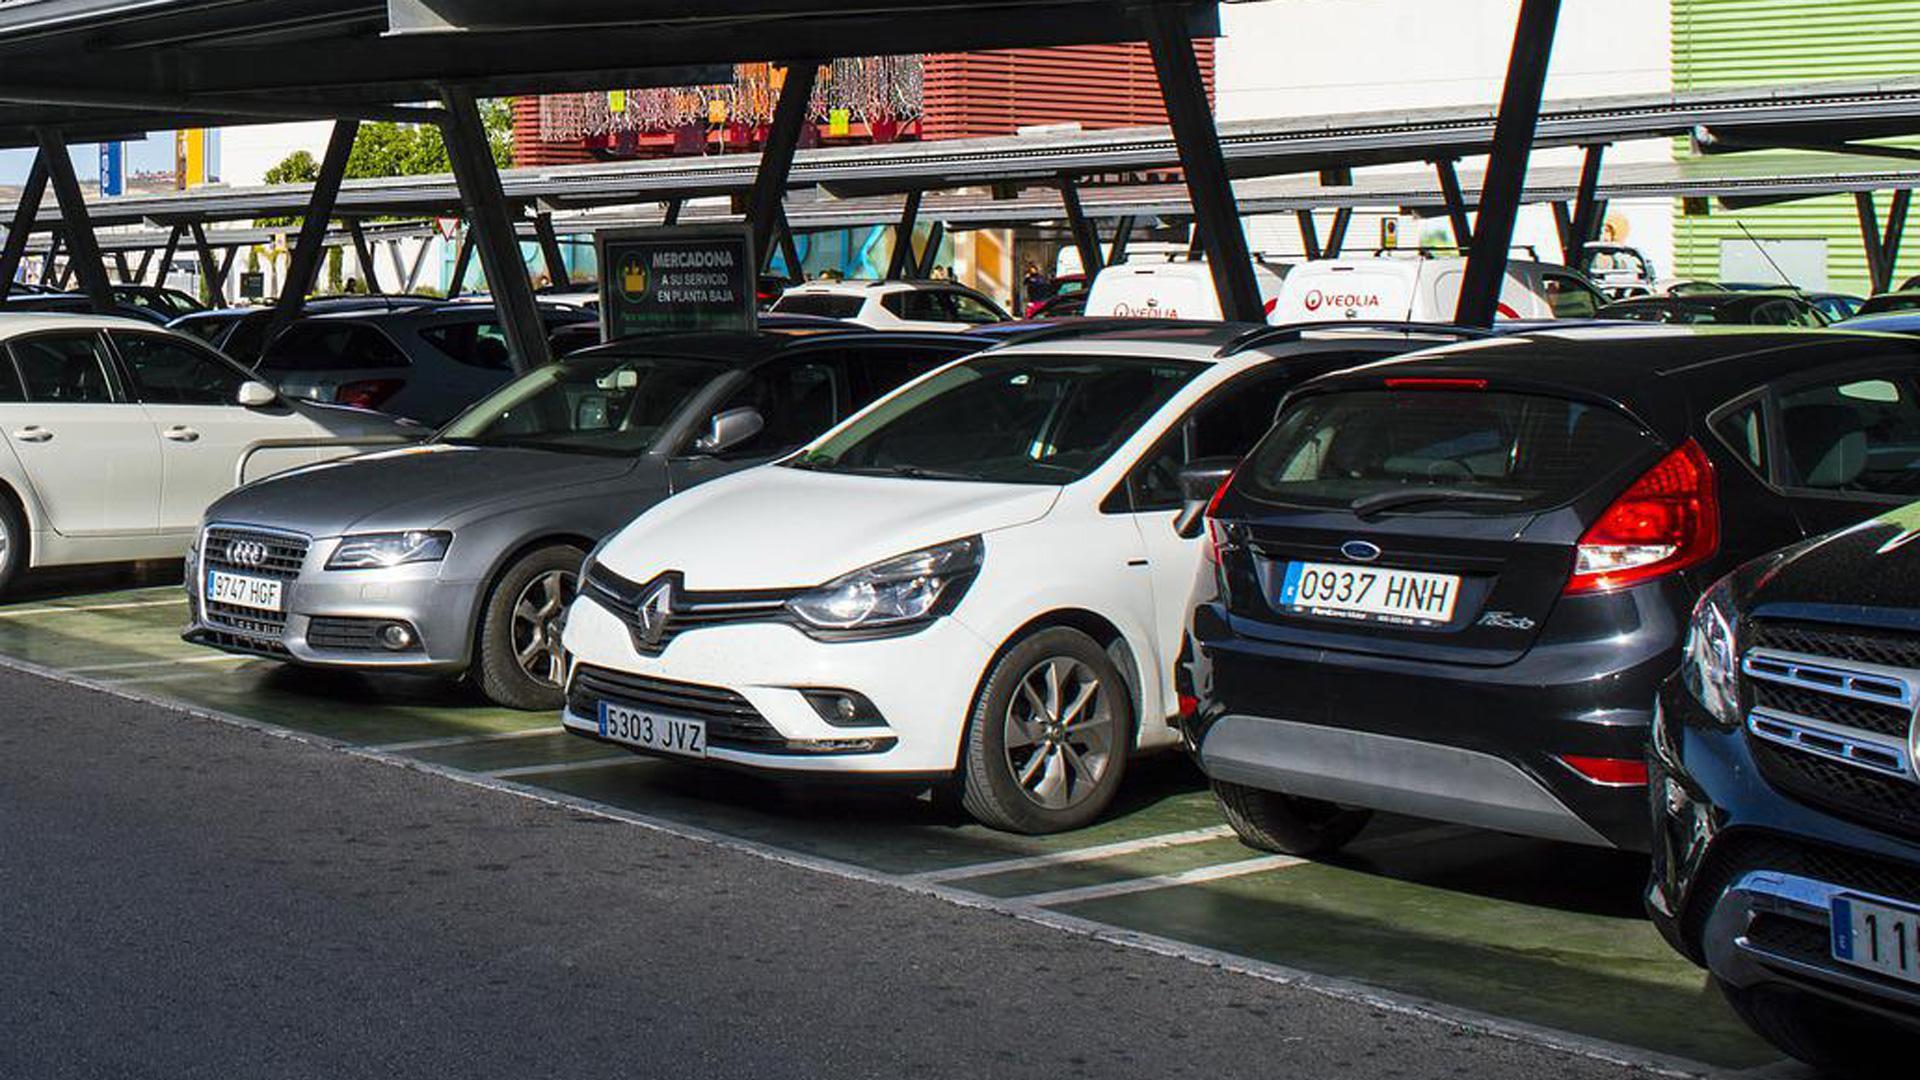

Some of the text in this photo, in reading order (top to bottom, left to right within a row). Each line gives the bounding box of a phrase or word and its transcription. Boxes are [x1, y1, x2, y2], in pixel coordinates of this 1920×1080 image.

[652, 251, 734, 268] MERCADONA
[662, 272, 728, 286] A SU SERVICIO
[657, 290, 734, 302] EN PLANTA BAJA
[1325, 294, 1379, 307] VEOLIA
[215, 575, 277, 604] 9747 HGF
[1301, 570, 1376, 604] 0937
[1384, 576, 1449, 612] HNH
[608, 709, 702, 752] 5303 JVZ
[1865, 914, 1920, 970] 11
